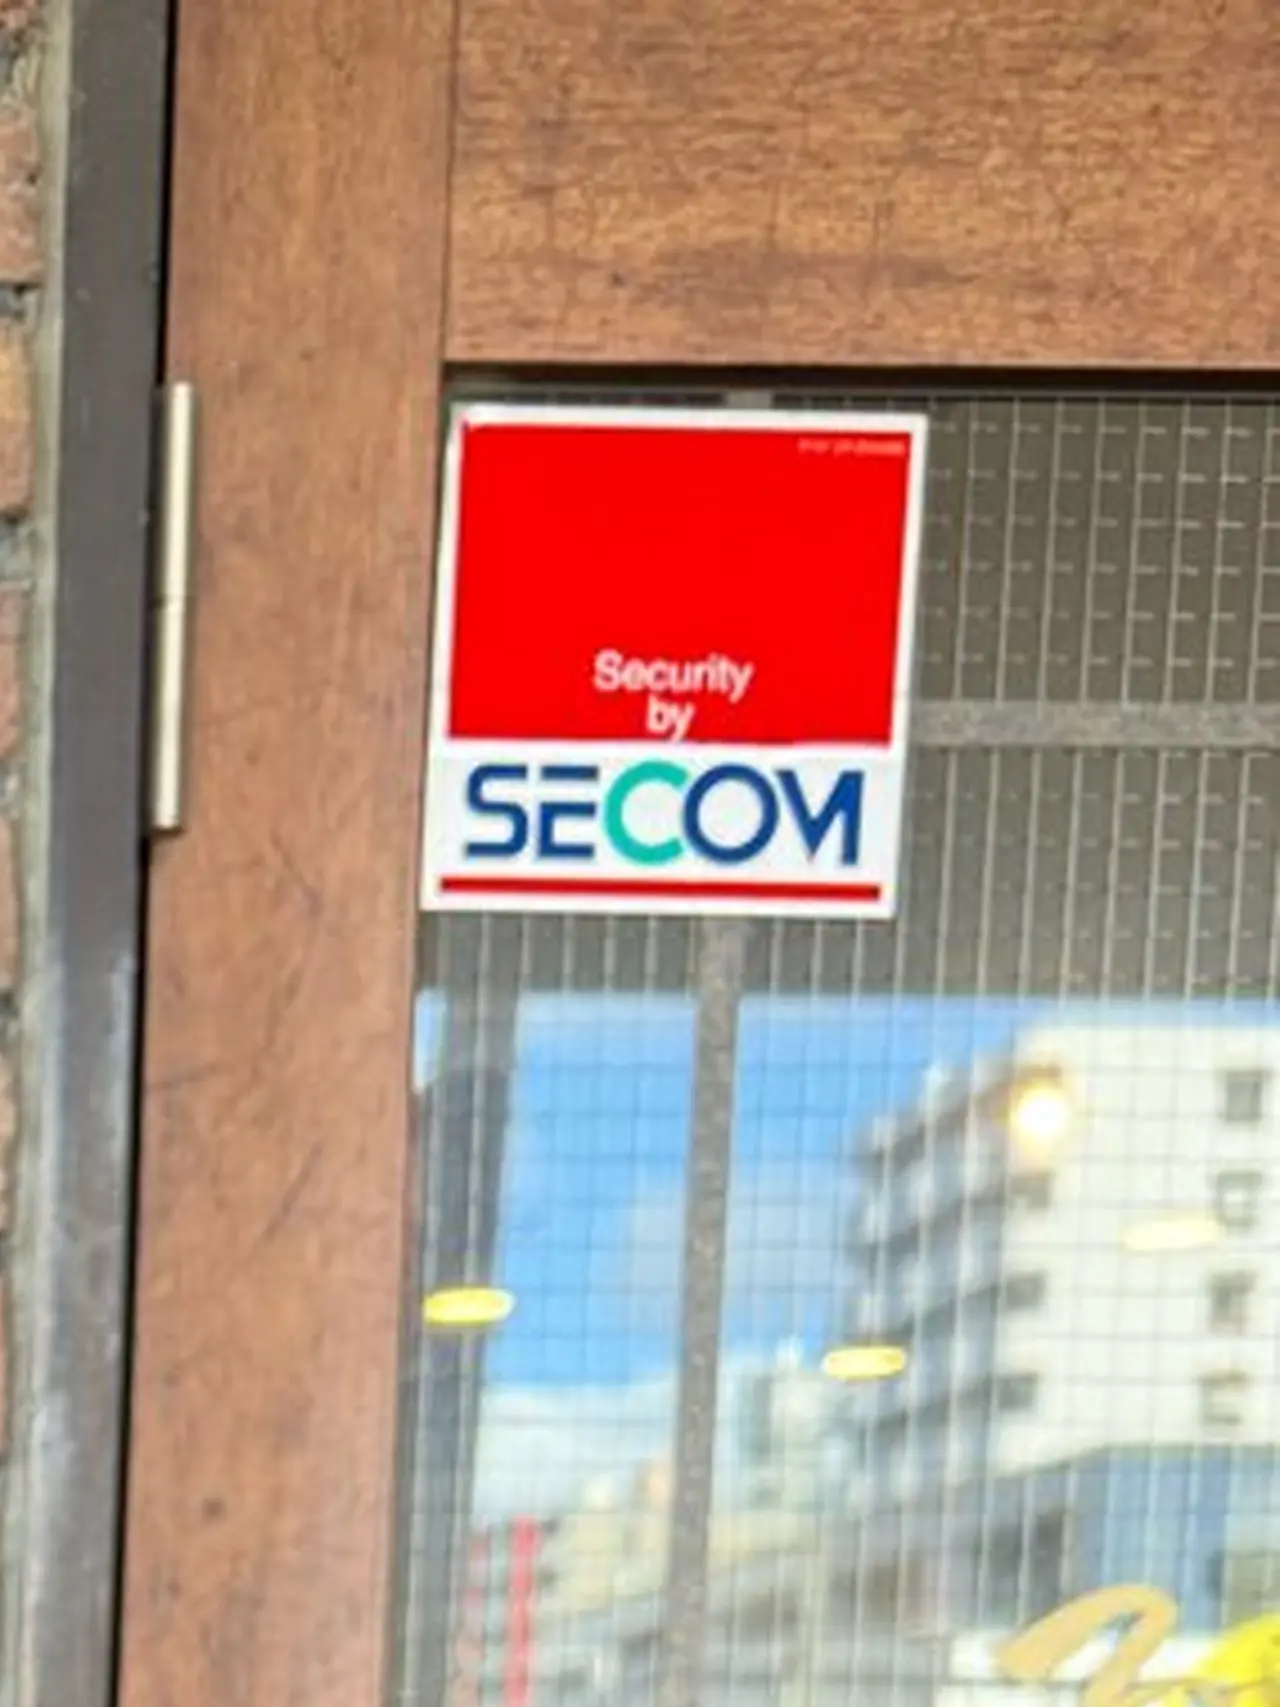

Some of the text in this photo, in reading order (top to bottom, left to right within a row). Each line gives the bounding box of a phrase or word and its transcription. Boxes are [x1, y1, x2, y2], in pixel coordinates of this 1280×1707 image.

[593, 648, 753, 702] Security
[646, 693, 696, 741] by
[464, 760, 865, 866] SECOM
